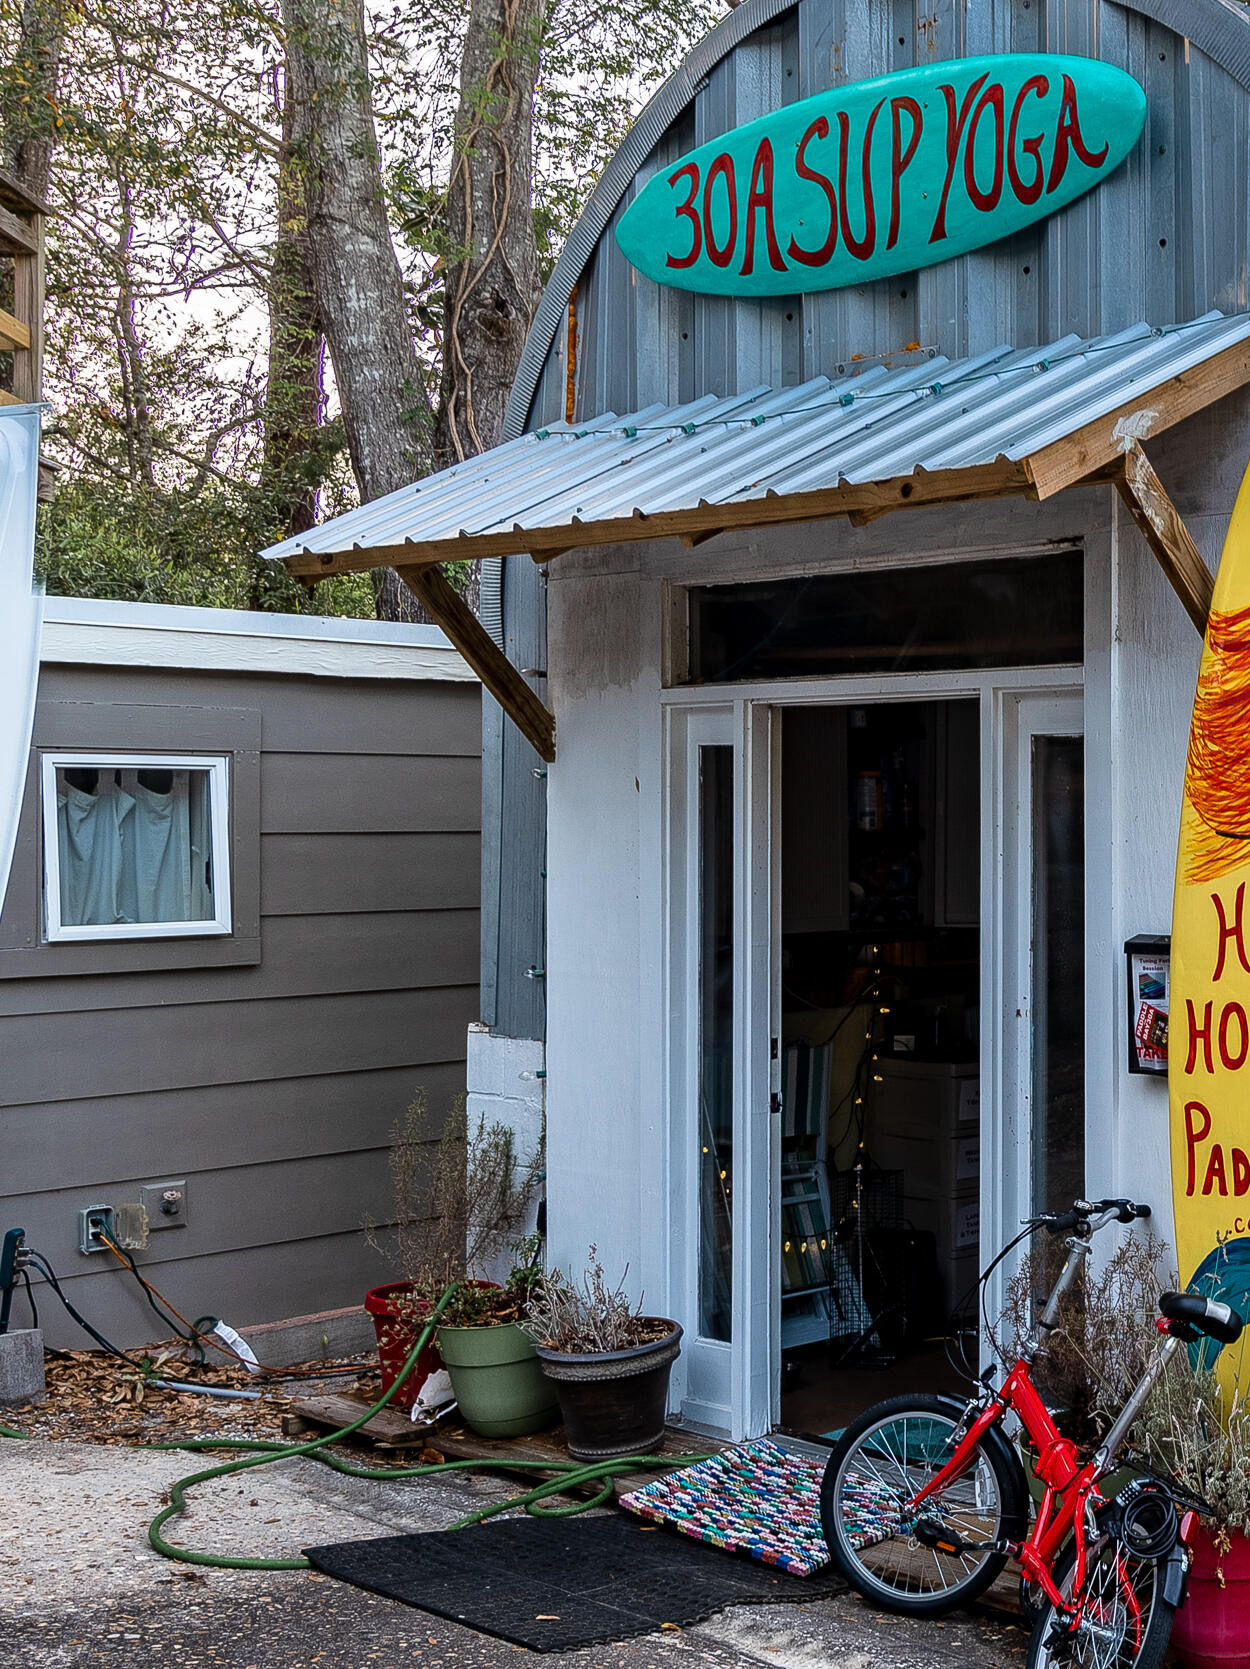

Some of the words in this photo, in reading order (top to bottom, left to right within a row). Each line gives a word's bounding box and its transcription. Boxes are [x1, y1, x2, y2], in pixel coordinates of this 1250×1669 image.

[665, 137, 789, 276] 30A
[786, 95, 924, 268] SUP
[928, 71, 1109, 244] YOGA
[1136, 1003, 1148, 1037] PADDLE
